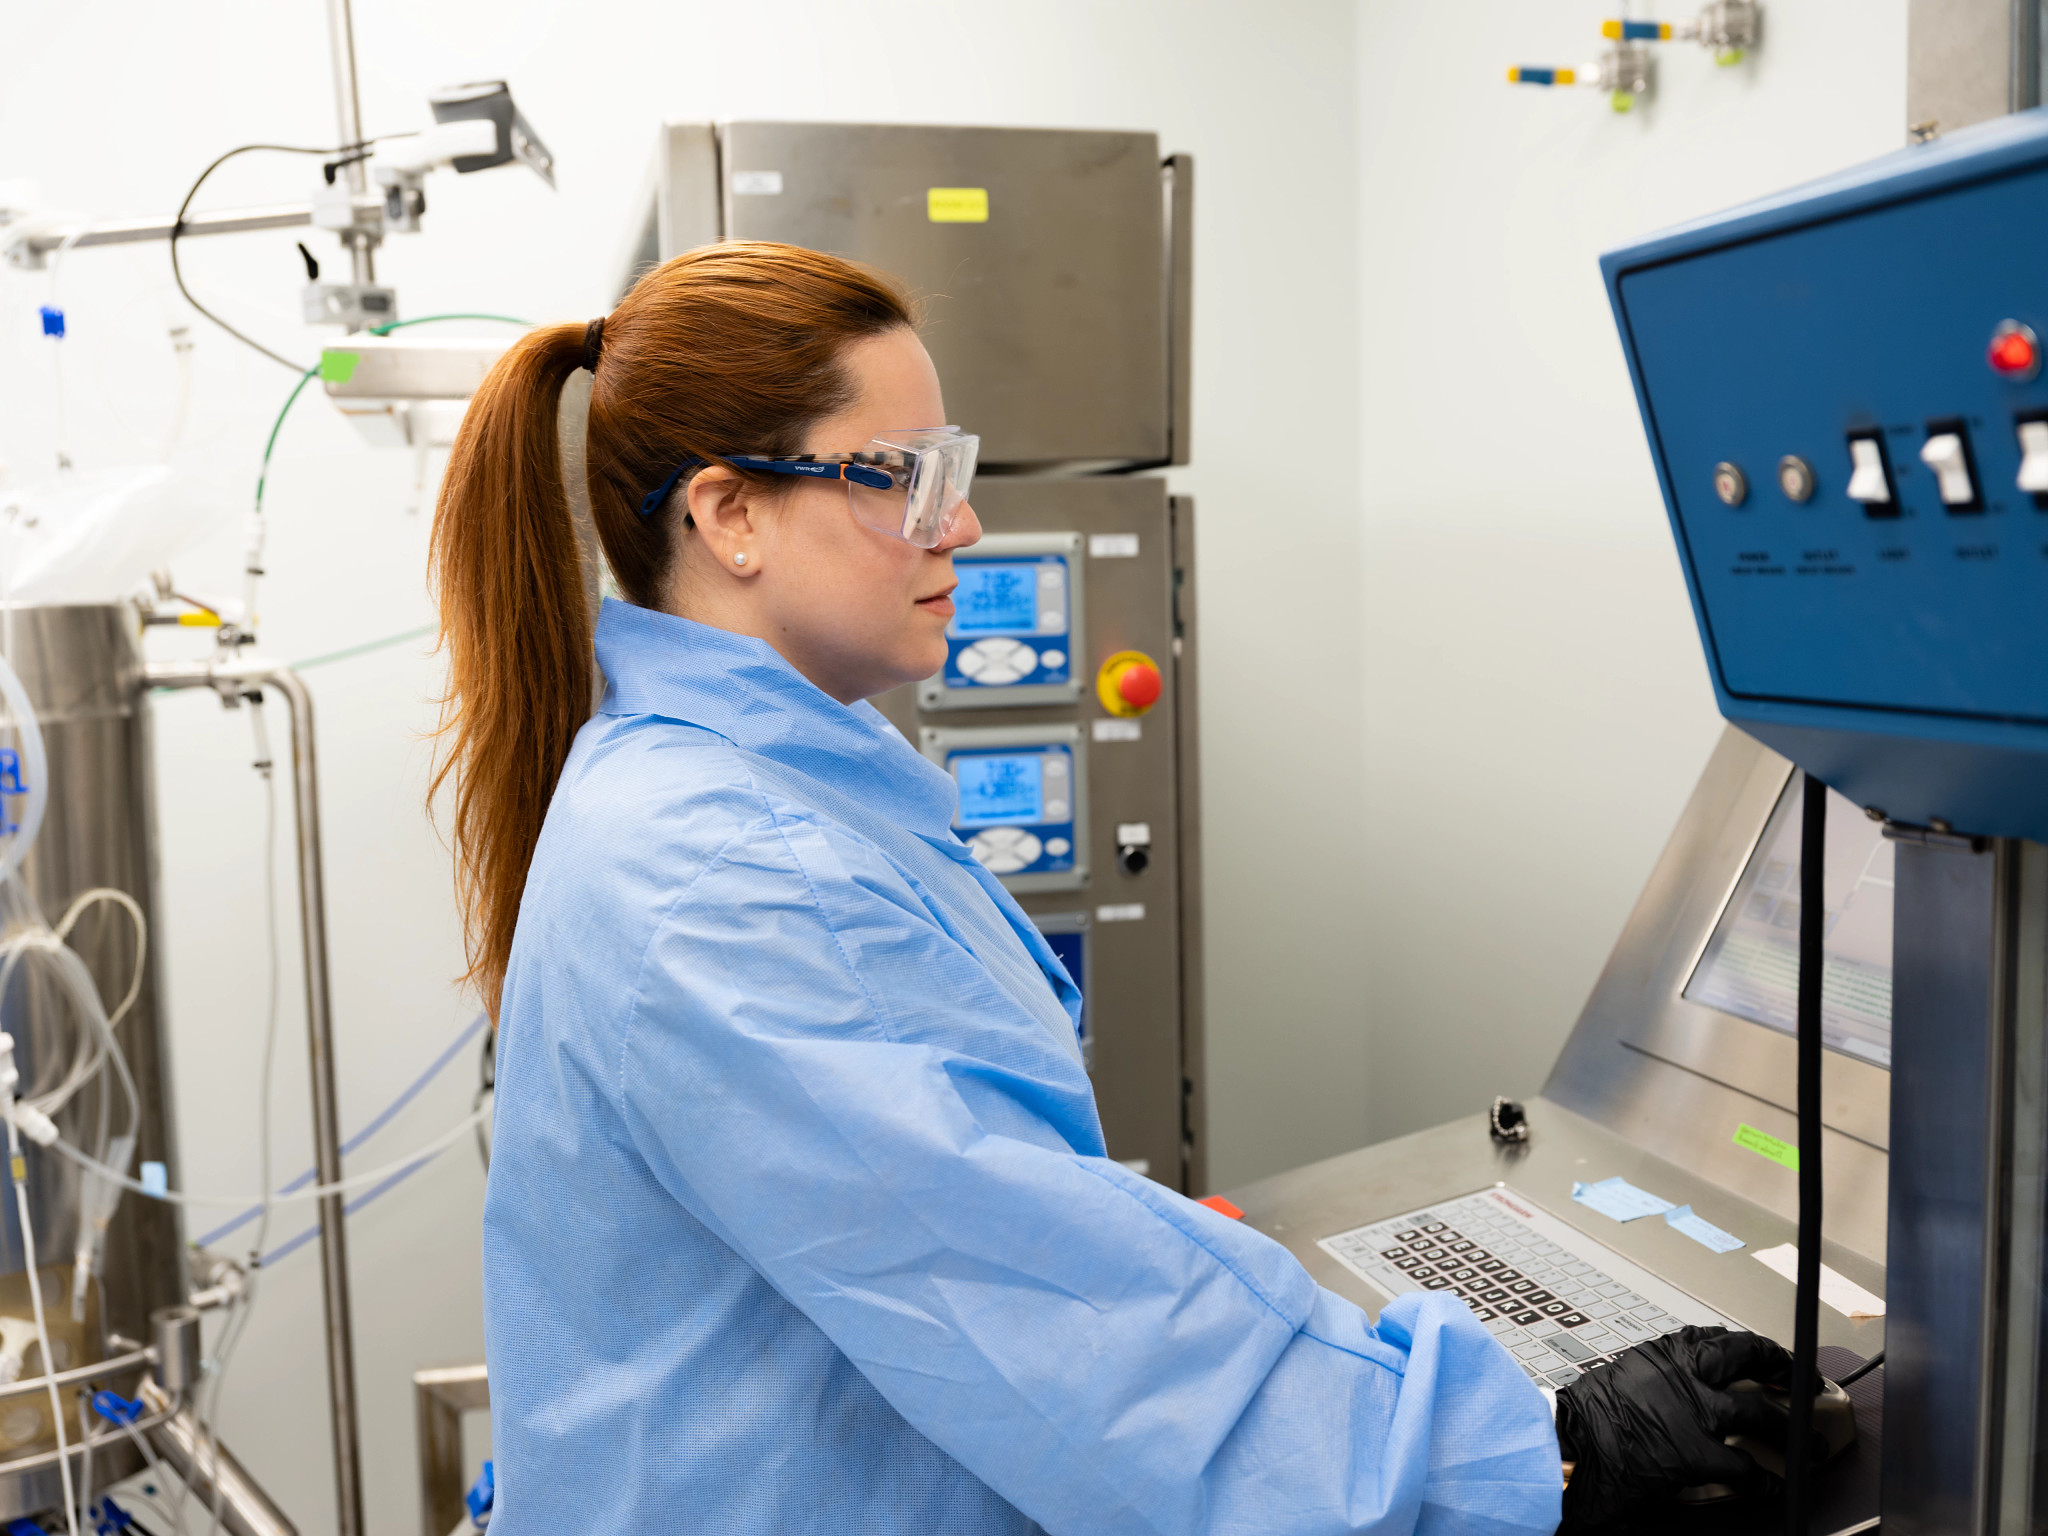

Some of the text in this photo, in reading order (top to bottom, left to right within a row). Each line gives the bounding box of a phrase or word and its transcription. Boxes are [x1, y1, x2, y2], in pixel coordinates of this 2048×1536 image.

[1400, 1231, 1416, 1240] A
[1440, 1231, 1459, 1241] W
[1413, 1240, 1429, 1249] S
[1454, 1241, 1471, 1251] E
[1386, 1248, 1404, 1257] Z
[1426, 1248, 1443, 1259] D
[1468, 1251, 1485, 1261] R
[1400, 1258, 1417, 1267] X
[1441, 1259, 1458, 1267] F
[1484, 1261, 1501, 1269] T
[1414, 1268, 1431, 1277] C
[1455, 1269, 1472, 1279] G
[1500, 1271, 1516, 1279] Y
[1428, 1278, 1446, 1287] V
[1470, 1280, 1488, 1289] H
[1514, 1281, 1532, 1291] U
[1500, 1302, 1519, 1311] K
[1546, 1303, 1564, 1313] O
[1517, 1313, 1532, 1322] L
[1563, 1315, 1581, 1323] P
[1618, 1316, 1642, 1332] Backspace
